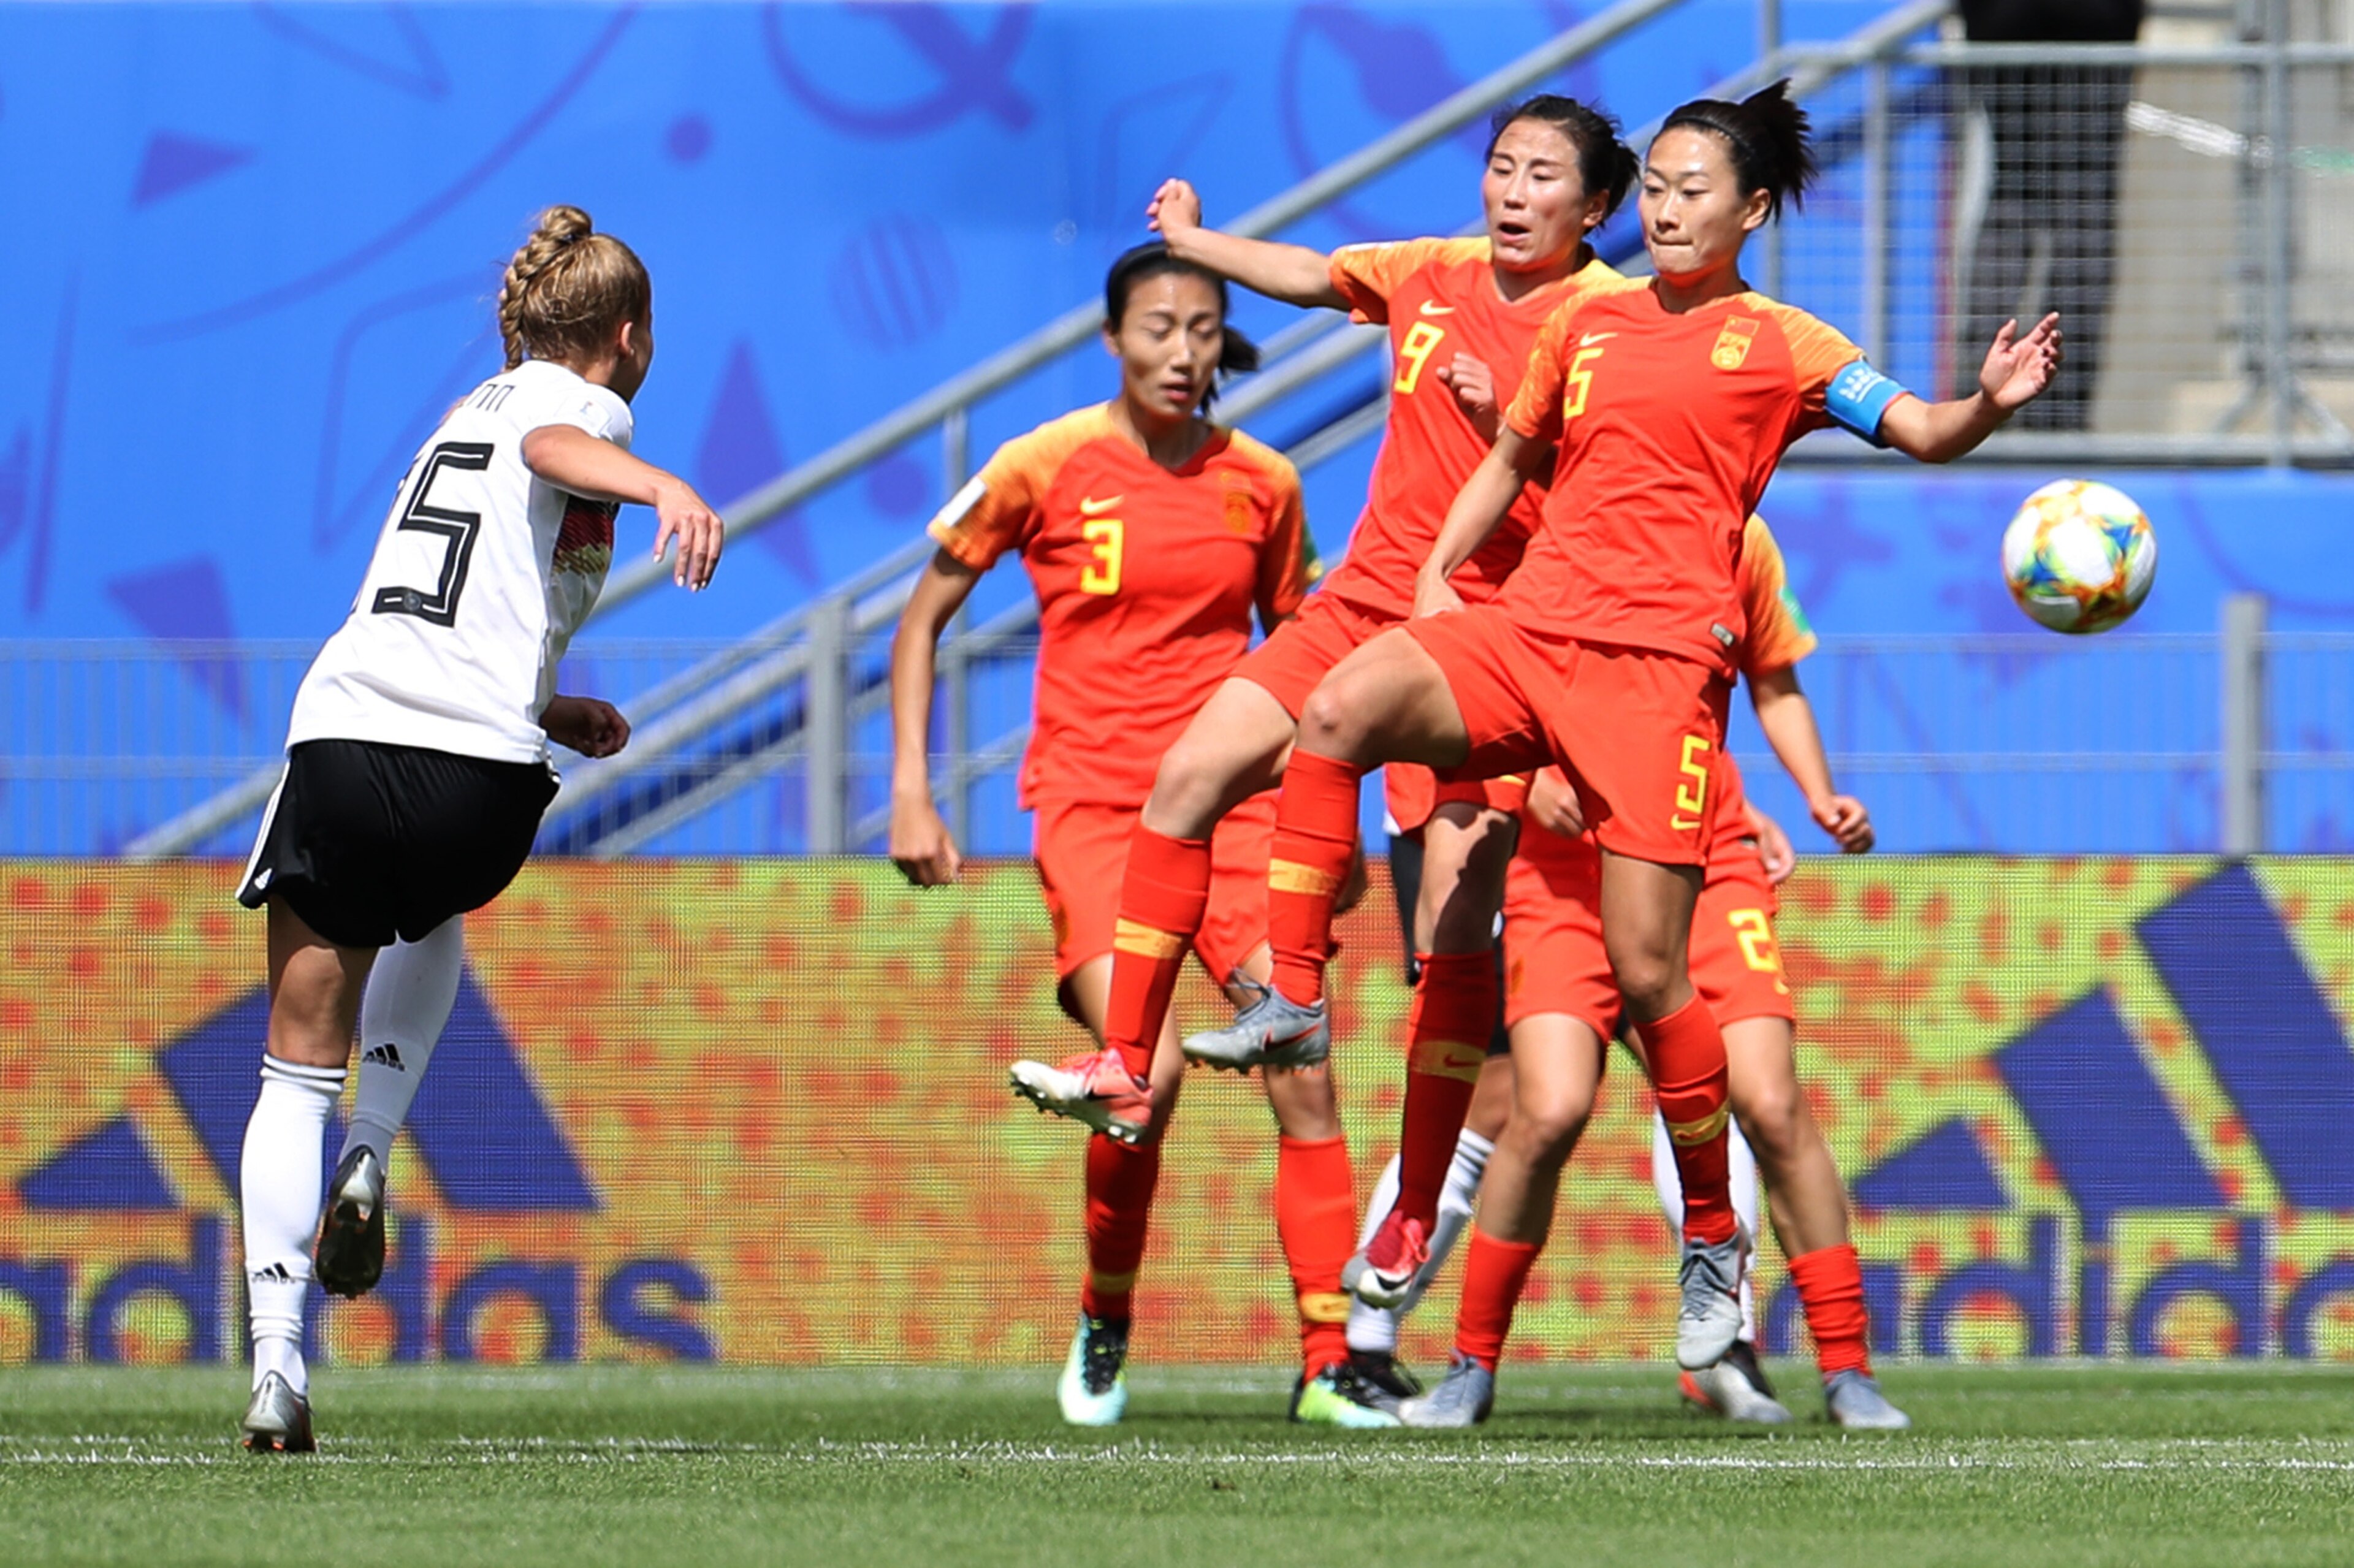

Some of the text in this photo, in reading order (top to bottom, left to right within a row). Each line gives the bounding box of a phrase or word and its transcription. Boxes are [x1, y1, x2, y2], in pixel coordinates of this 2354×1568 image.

[1394, 321, 1445, 394] 9
[1564, 347, 1604, 419] 5
[1080, 519, 1124, 595] 3
[1676, 734, 1710, 813] 5
[0, 1216, 720, 1363] addas
